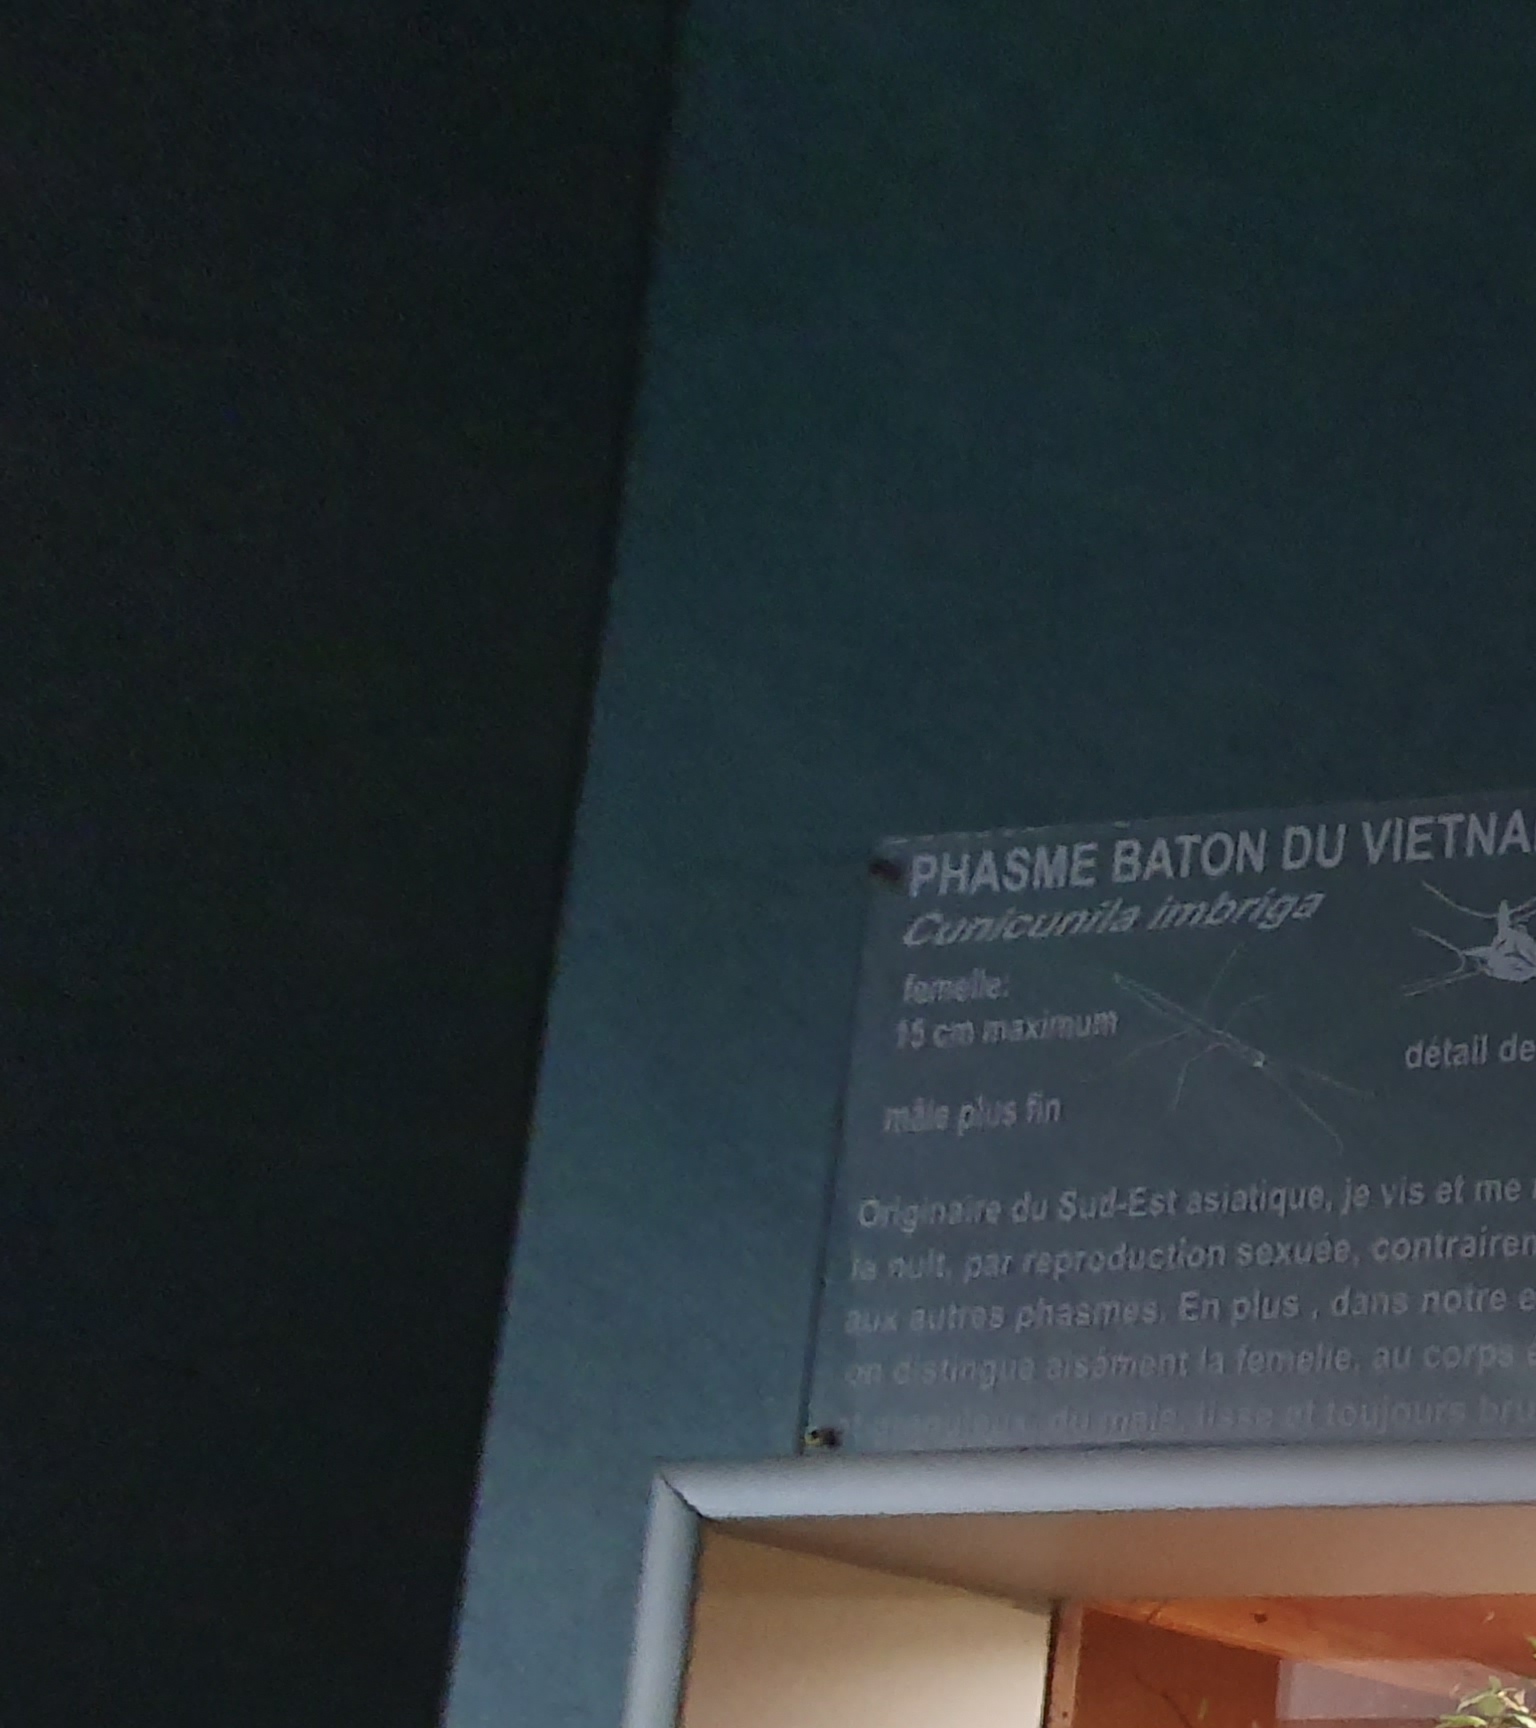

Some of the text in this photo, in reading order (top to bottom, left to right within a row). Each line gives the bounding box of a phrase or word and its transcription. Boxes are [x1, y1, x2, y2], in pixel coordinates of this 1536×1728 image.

[909, 844, 1098, 897] PHASME
[1114, 831, 1264, 881] BATON
[1280, 821, 1346, 870] DU
[1148, 888, 1326, 931] imbriga
[896, 1010, 1119, 1050] 15 cm maximum
[1405, 1031, 1488, 1068] détail
[883, 1090, 1061, 1137] mâle plus fin
[858, 1196, 1001, 1234] Originaire
[1011, 1192, 1048, 1223] du
[1057, 1186, 1177, 1222] Sud-Est
[1185, 1182, 1332, 1218] asiatique,
[1341, 1177, 1371, 1215] je
[1380, 1176, 1425, 1206] vis
[1435, 1176, 1465, 1204] et
[1474, 1178, 1521, 1202] me
[964, 1252, 1011, 1284] par
[1022, 1238, 1226, 1280] reproduction
[844, 1309, 898, 1335] aux
[910, 1302, 1004, 1331] autres
[1178, 1290, 1220, 1320] En
[1232, 1290, 1299, 1326] plus
[1331, 1287, 1408, 1317] dans
[1421, 1285, 1507, 1312] notre
[893, 1353, 1035, 1390] distingue
[1199, 1346, 1225, 1375] la
[1374, 1348, 1412, 1371] au
[1422, 1345, 1514, 1373] corps
